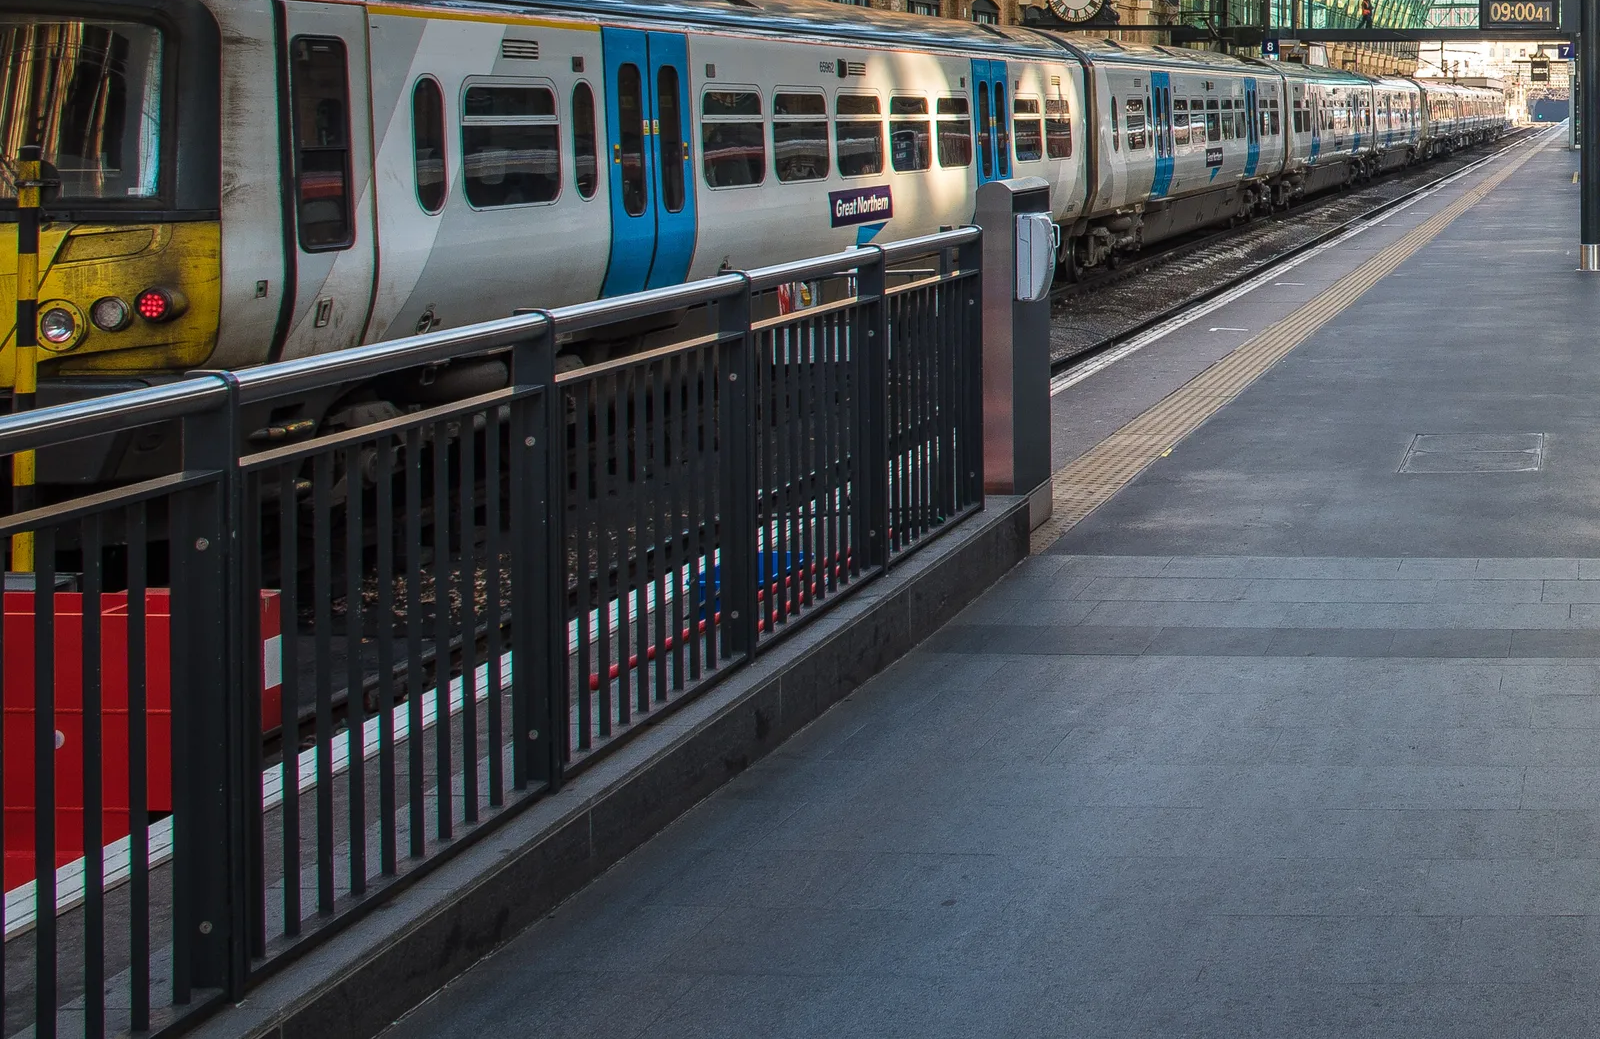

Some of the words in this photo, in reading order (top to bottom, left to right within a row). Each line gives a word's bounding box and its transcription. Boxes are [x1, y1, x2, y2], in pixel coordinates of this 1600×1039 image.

[1266, 42, 1274, 52] 8
[1562, 46, 1570, 56] 7
[836, 198, 857, 218] Great
[857, 194, 889, 214] Northern
